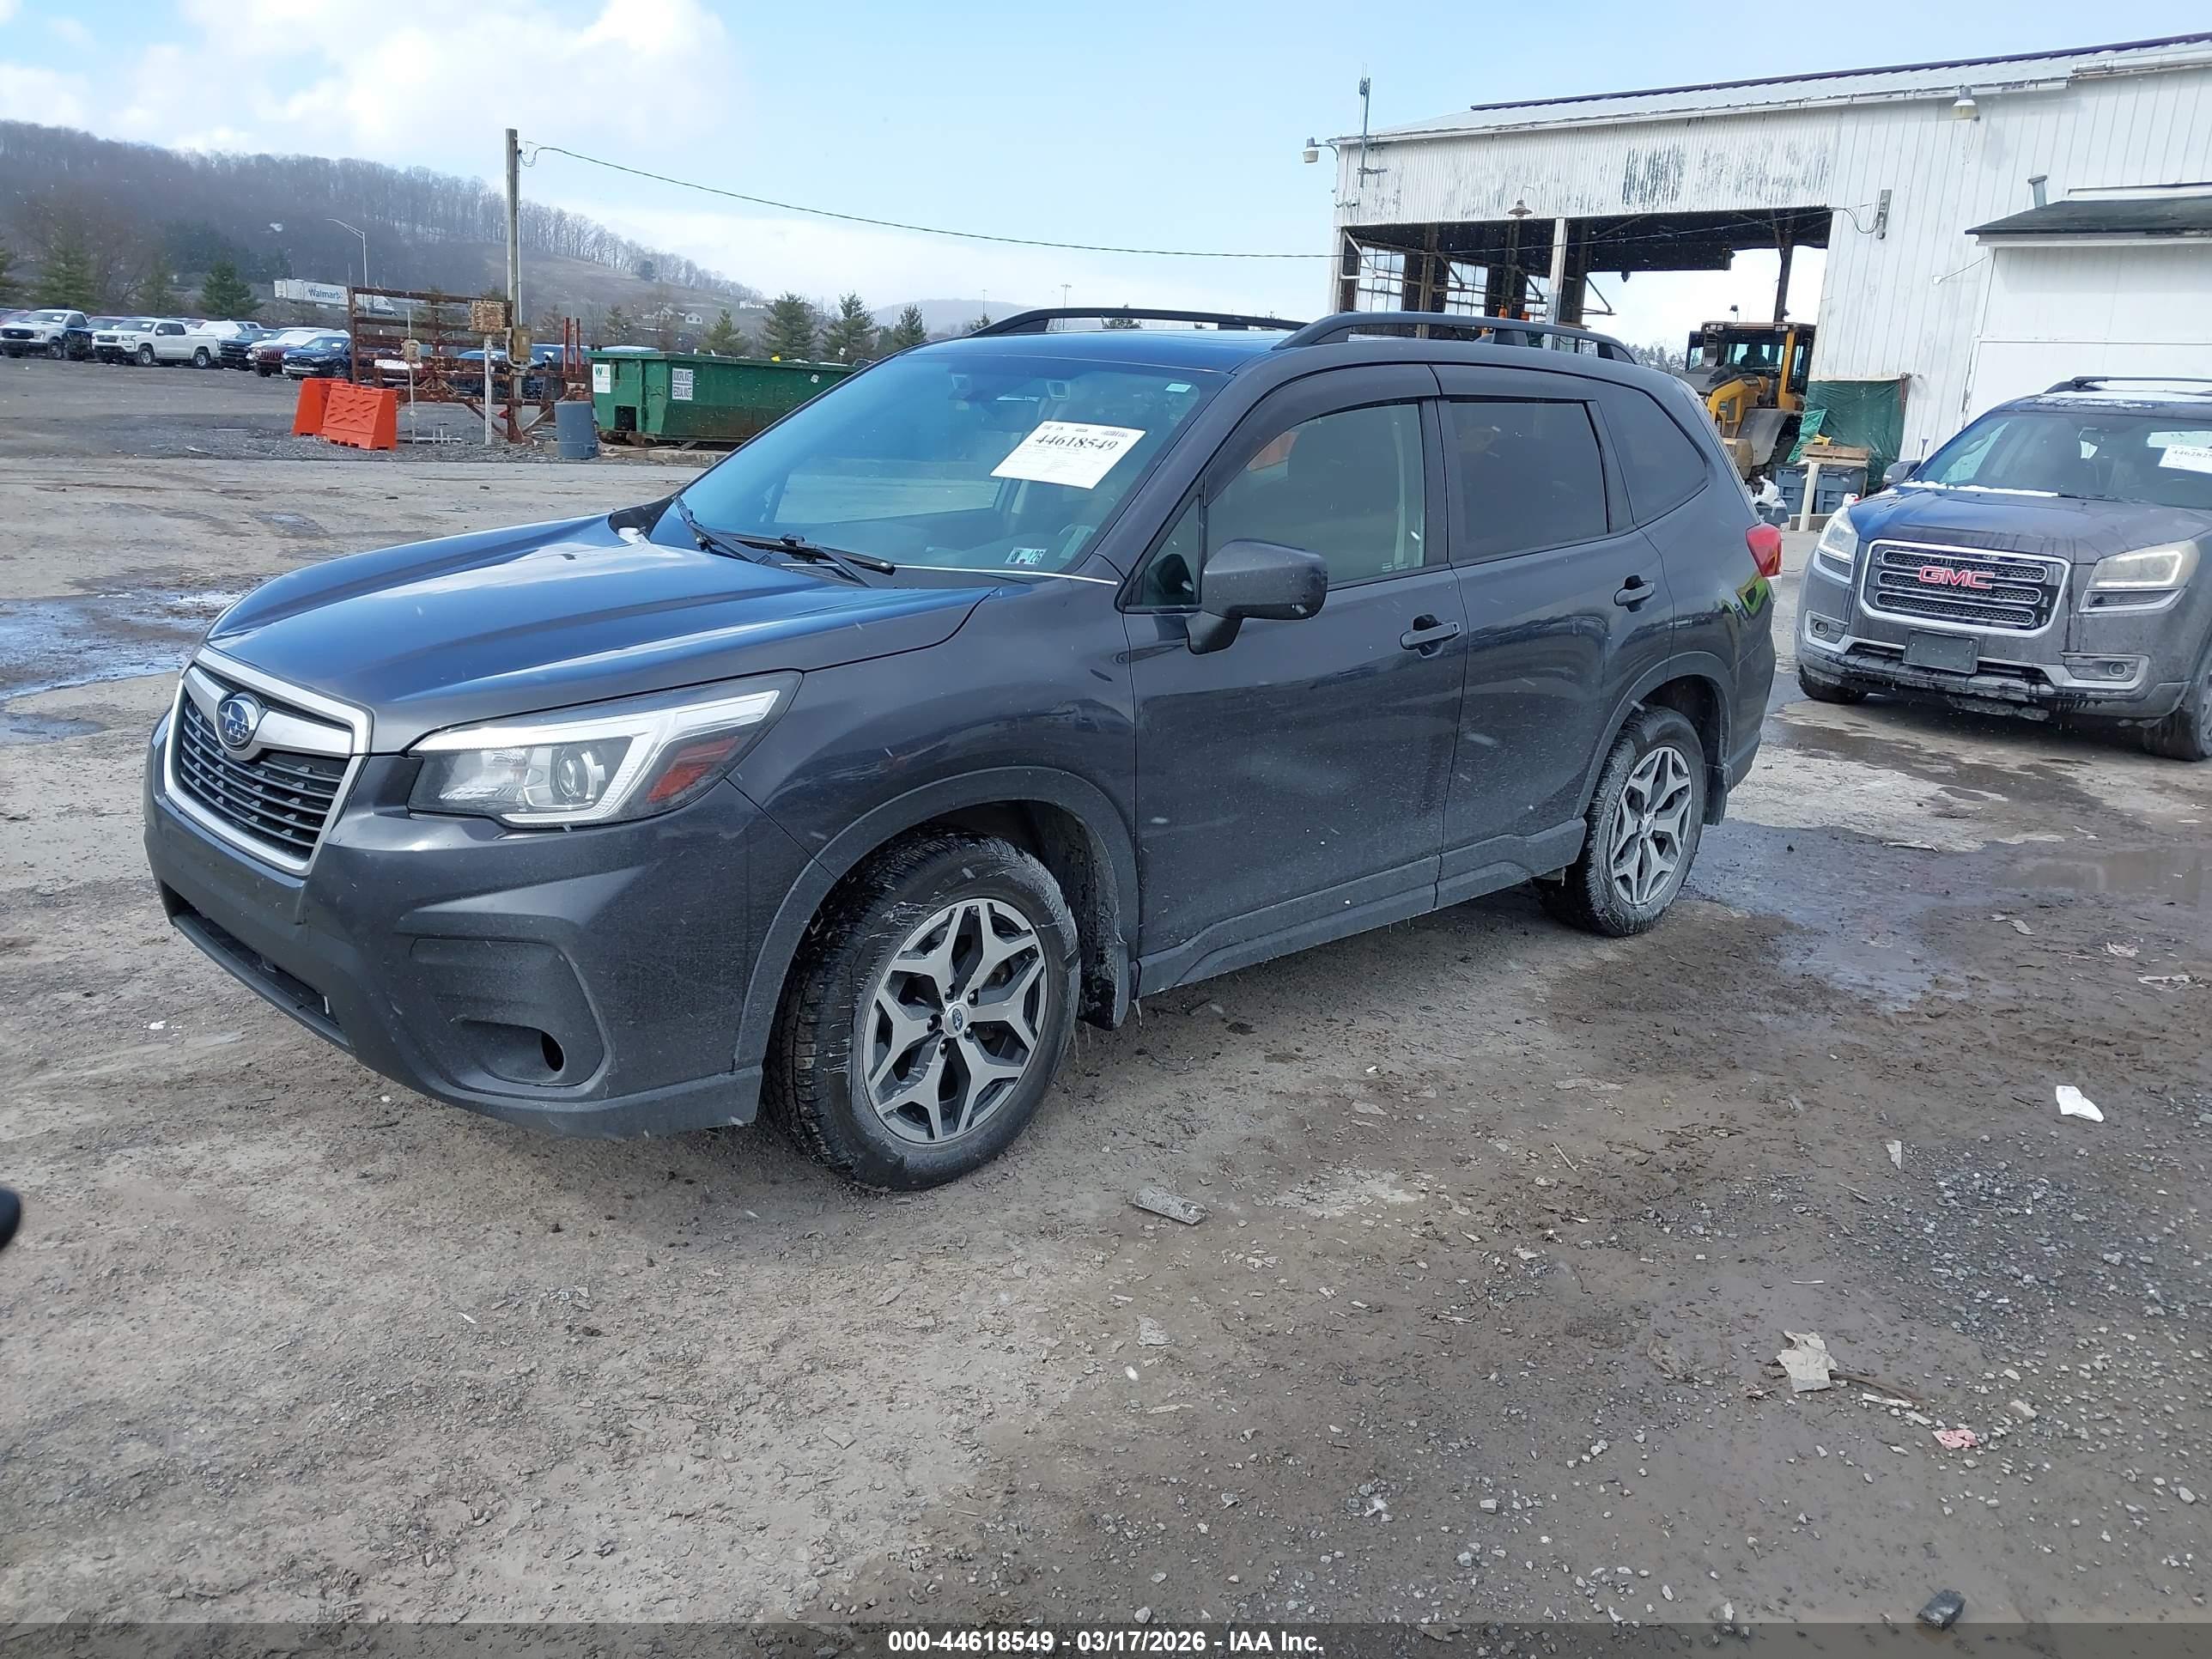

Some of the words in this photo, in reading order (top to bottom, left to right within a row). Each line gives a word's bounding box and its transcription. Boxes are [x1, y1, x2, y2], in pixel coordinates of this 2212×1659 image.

[309, 288, 340, 300] Walmart
[1036, 434, 1118, 452] 44618549
[1919, 566, 1995, 590] GMC
